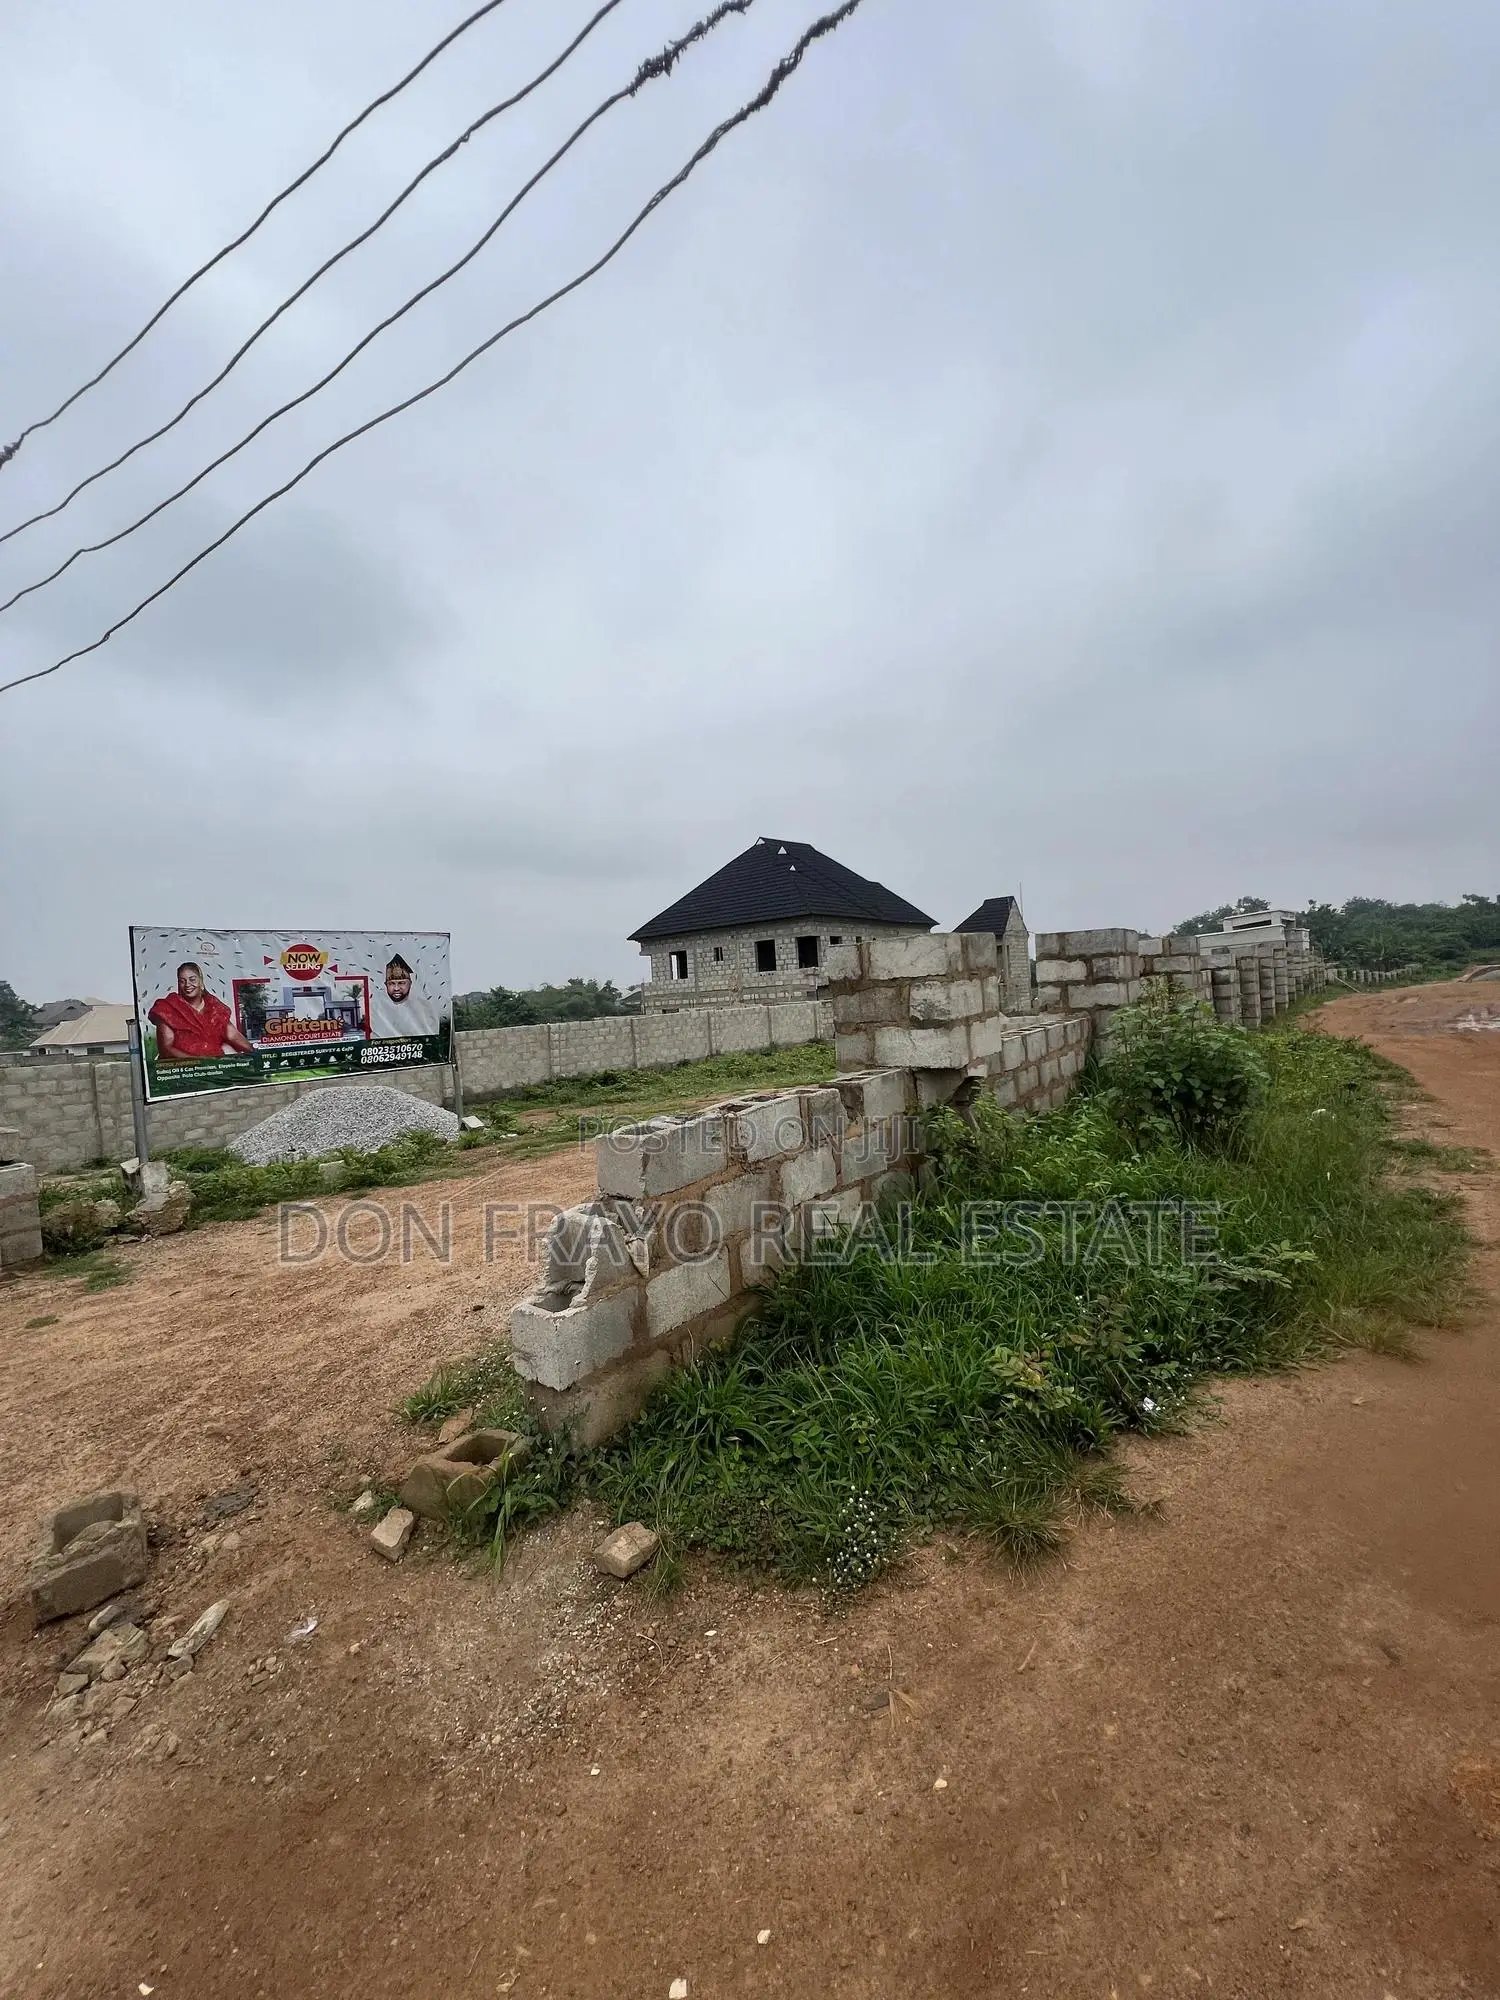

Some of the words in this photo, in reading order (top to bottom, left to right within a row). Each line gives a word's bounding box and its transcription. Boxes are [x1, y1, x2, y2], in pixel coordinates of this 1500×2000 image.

[287, 953, 321, 964] NOW
[286, 963, 320, 971] SELLING
[262, 1035, 297, 1043] DIAMOND
[298, 1032, 320, 1040] COURT
[281, 1049, 315, 1057] REGISTERED
[361, 1043, 423, 1056] 08023510670
[361, 1051, 423, 1064] 08062949148
